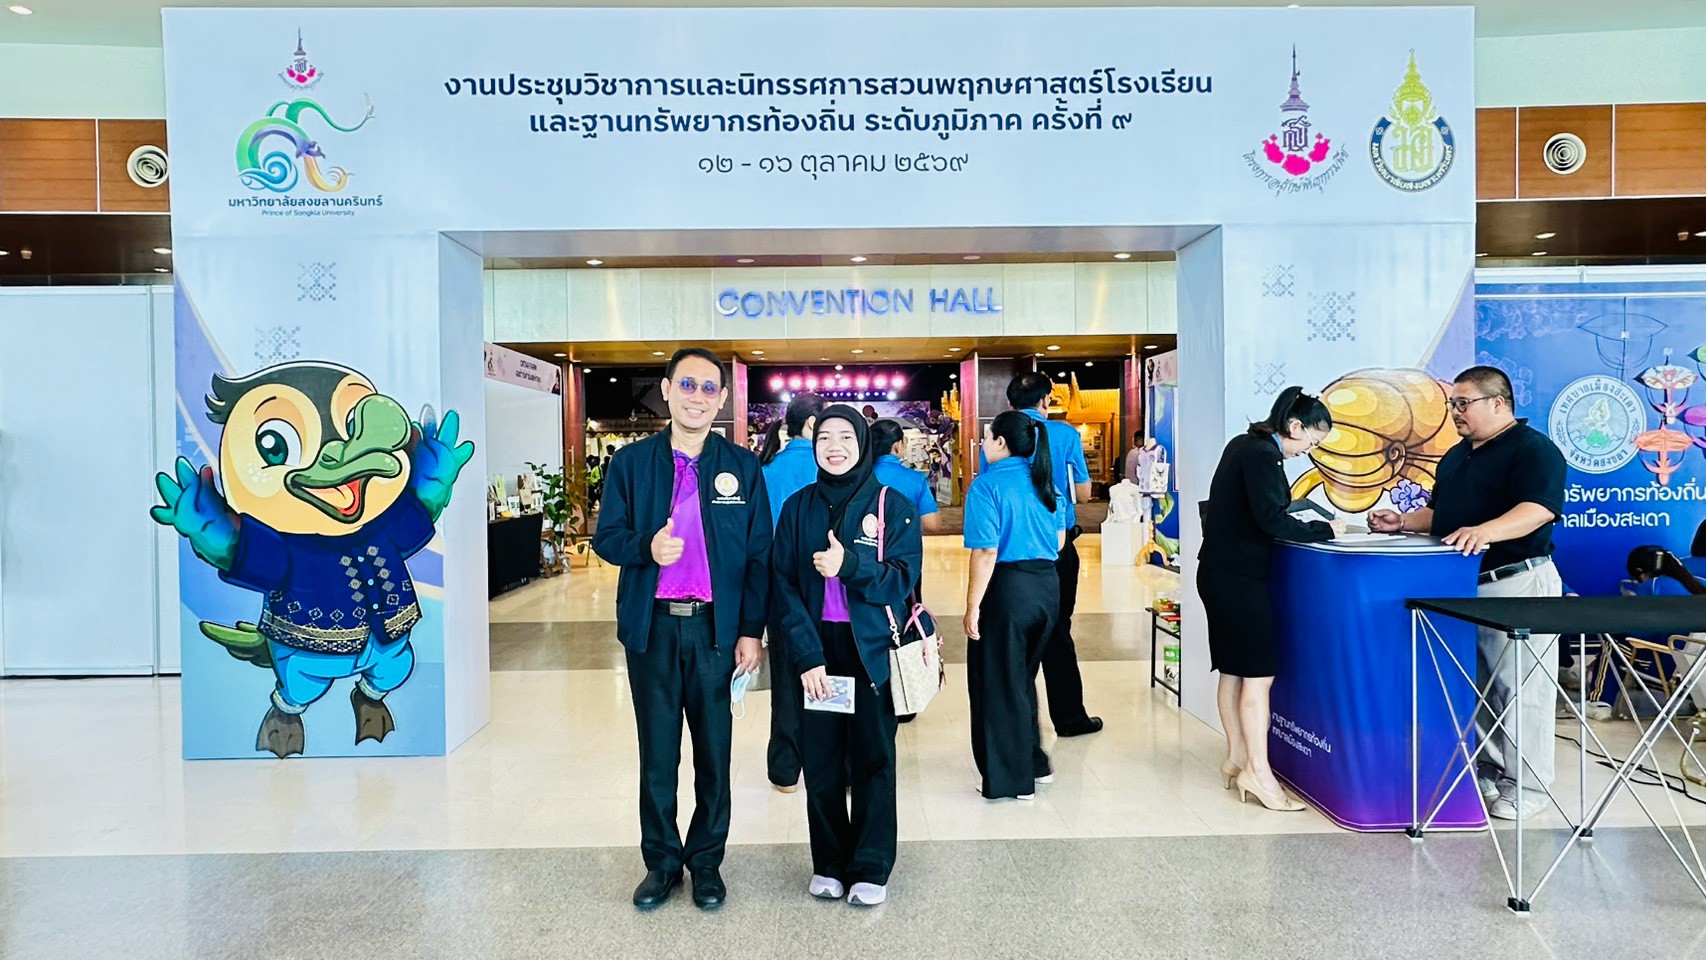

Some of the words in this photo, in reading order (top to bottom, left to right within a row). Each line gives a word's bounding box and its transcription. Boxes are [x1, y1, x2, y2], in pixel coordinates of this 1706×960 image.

[444, 68, 1213, 107] งานประชุมวิชาการและนิทรรศการสวนพฤกษศาสตร์โรงเรียน
[529, 98, 855, 139] และฐานทรัพยากรท้องถิ่น
[864, 106, 1023, 141] ระดับภูมิภาค
[1032, 98, 1104, 130] ครั้งที่
[1111, 112, 1133, 130] ๙
[698, 154, 734, 173] ๑๒
[758, 155, 793, 173] ๑๖
[800, 153, 886, 181] ตุลาคม
[894, 152, 969, 173] ๒๕๖๙
[228, 194, 383, 207] มหาวิทยาลัยสงขลานครินทร์
[261, 209, 284, 217] Prince
[285, 209, 293, 217] of
[294, 209, 320, 219] Songkla
[321, 209, 355, 218] University
[715, 288, 914, 318] CONVENTION
[929, 286, 1003, 314] HALL
